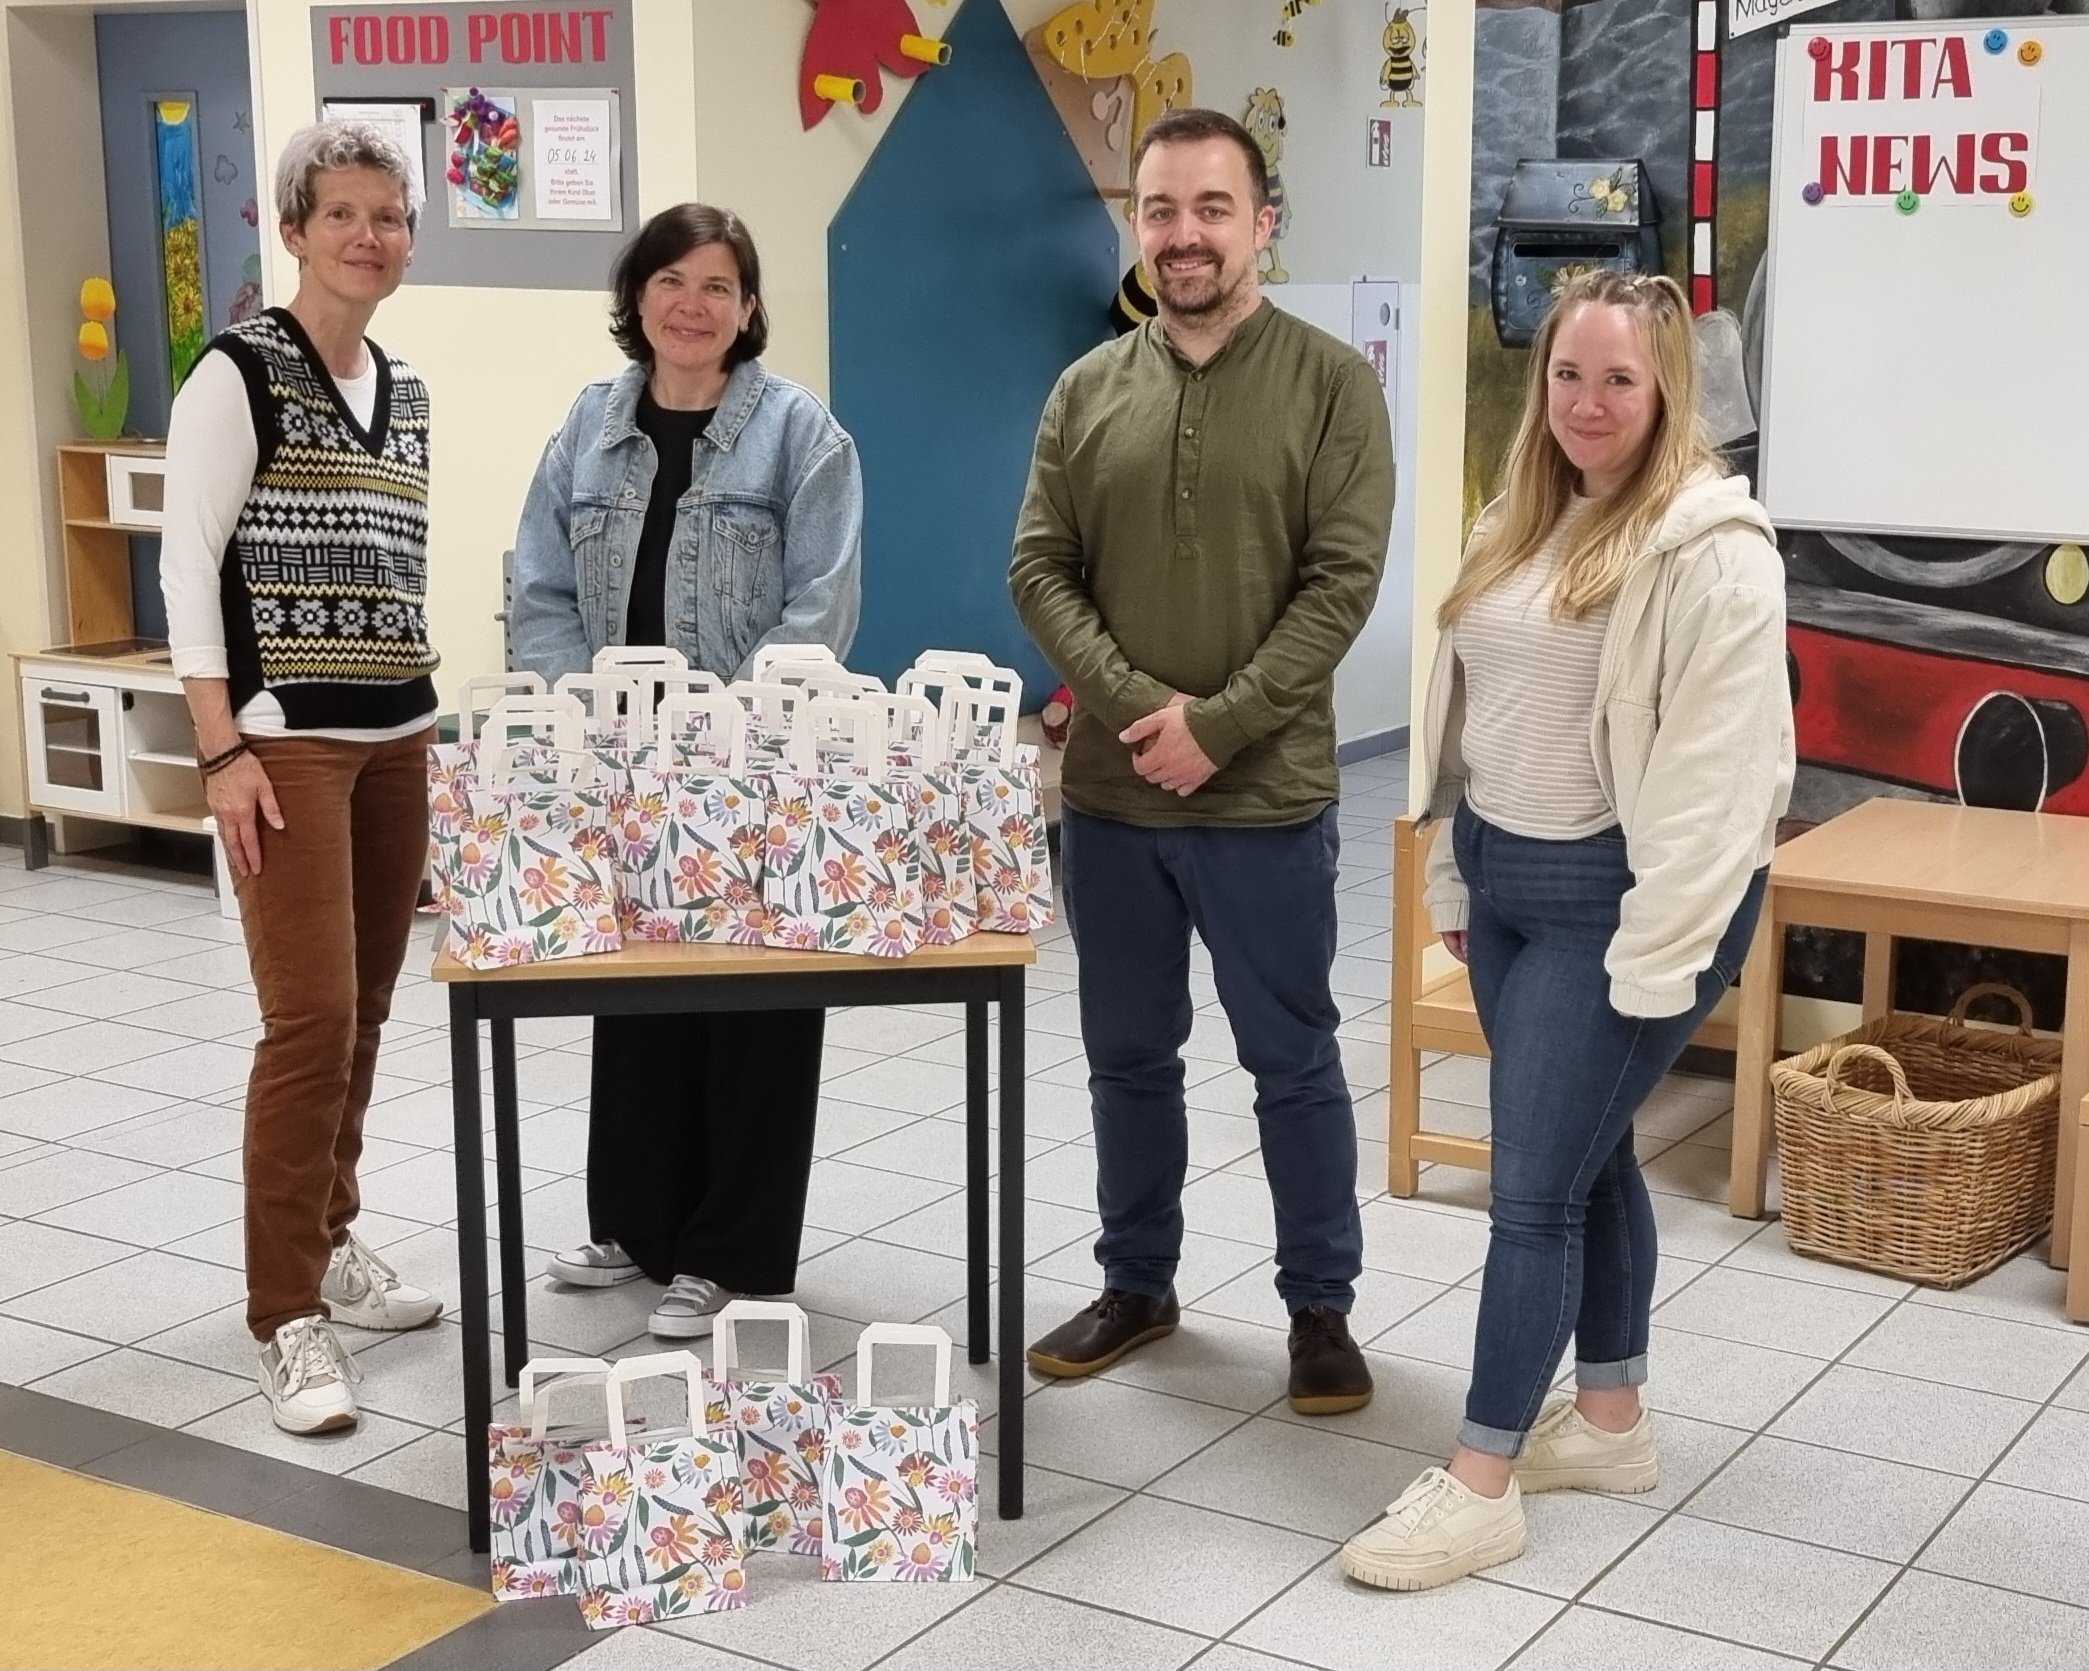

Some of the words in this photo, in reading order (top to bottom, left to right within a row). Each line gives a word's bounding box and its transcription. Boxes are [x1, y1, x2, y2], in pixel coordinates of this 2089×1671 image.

[329, 15, 450, 65] FOOD
[468, 10, 613, 64] POINT
[1813, 37, 1973, 102] KITA
[1819, 132, 2029, 196] NEWS
